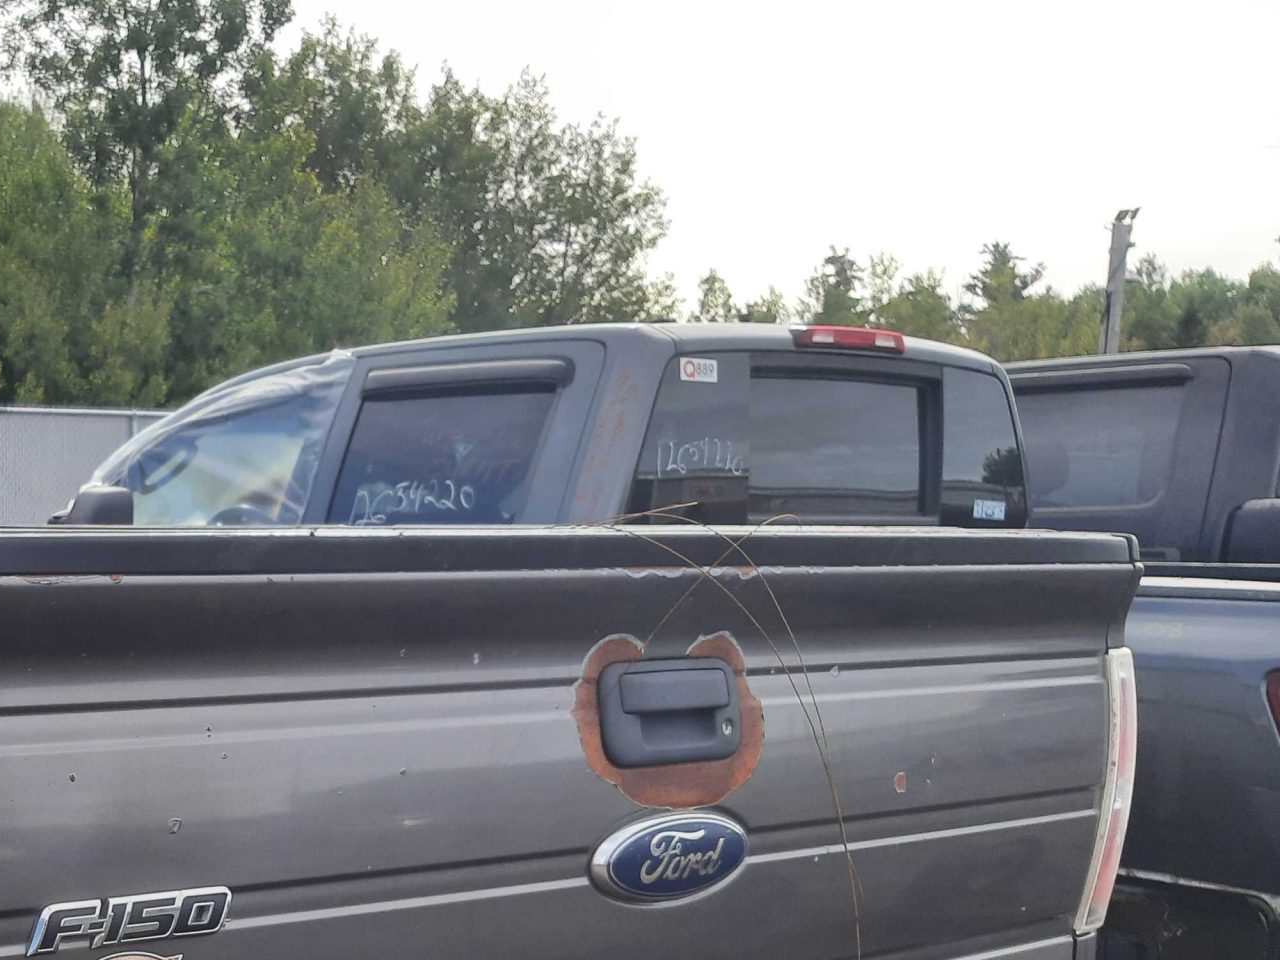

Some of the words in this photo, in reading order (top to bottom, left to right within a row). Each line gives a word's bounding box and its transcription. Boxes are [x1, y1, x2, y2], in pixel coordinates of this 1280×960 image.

[683, 360, 714, 378] Q889
[640, 829, 724, 883] Ford
[26, 886, 232, 956] F-150
